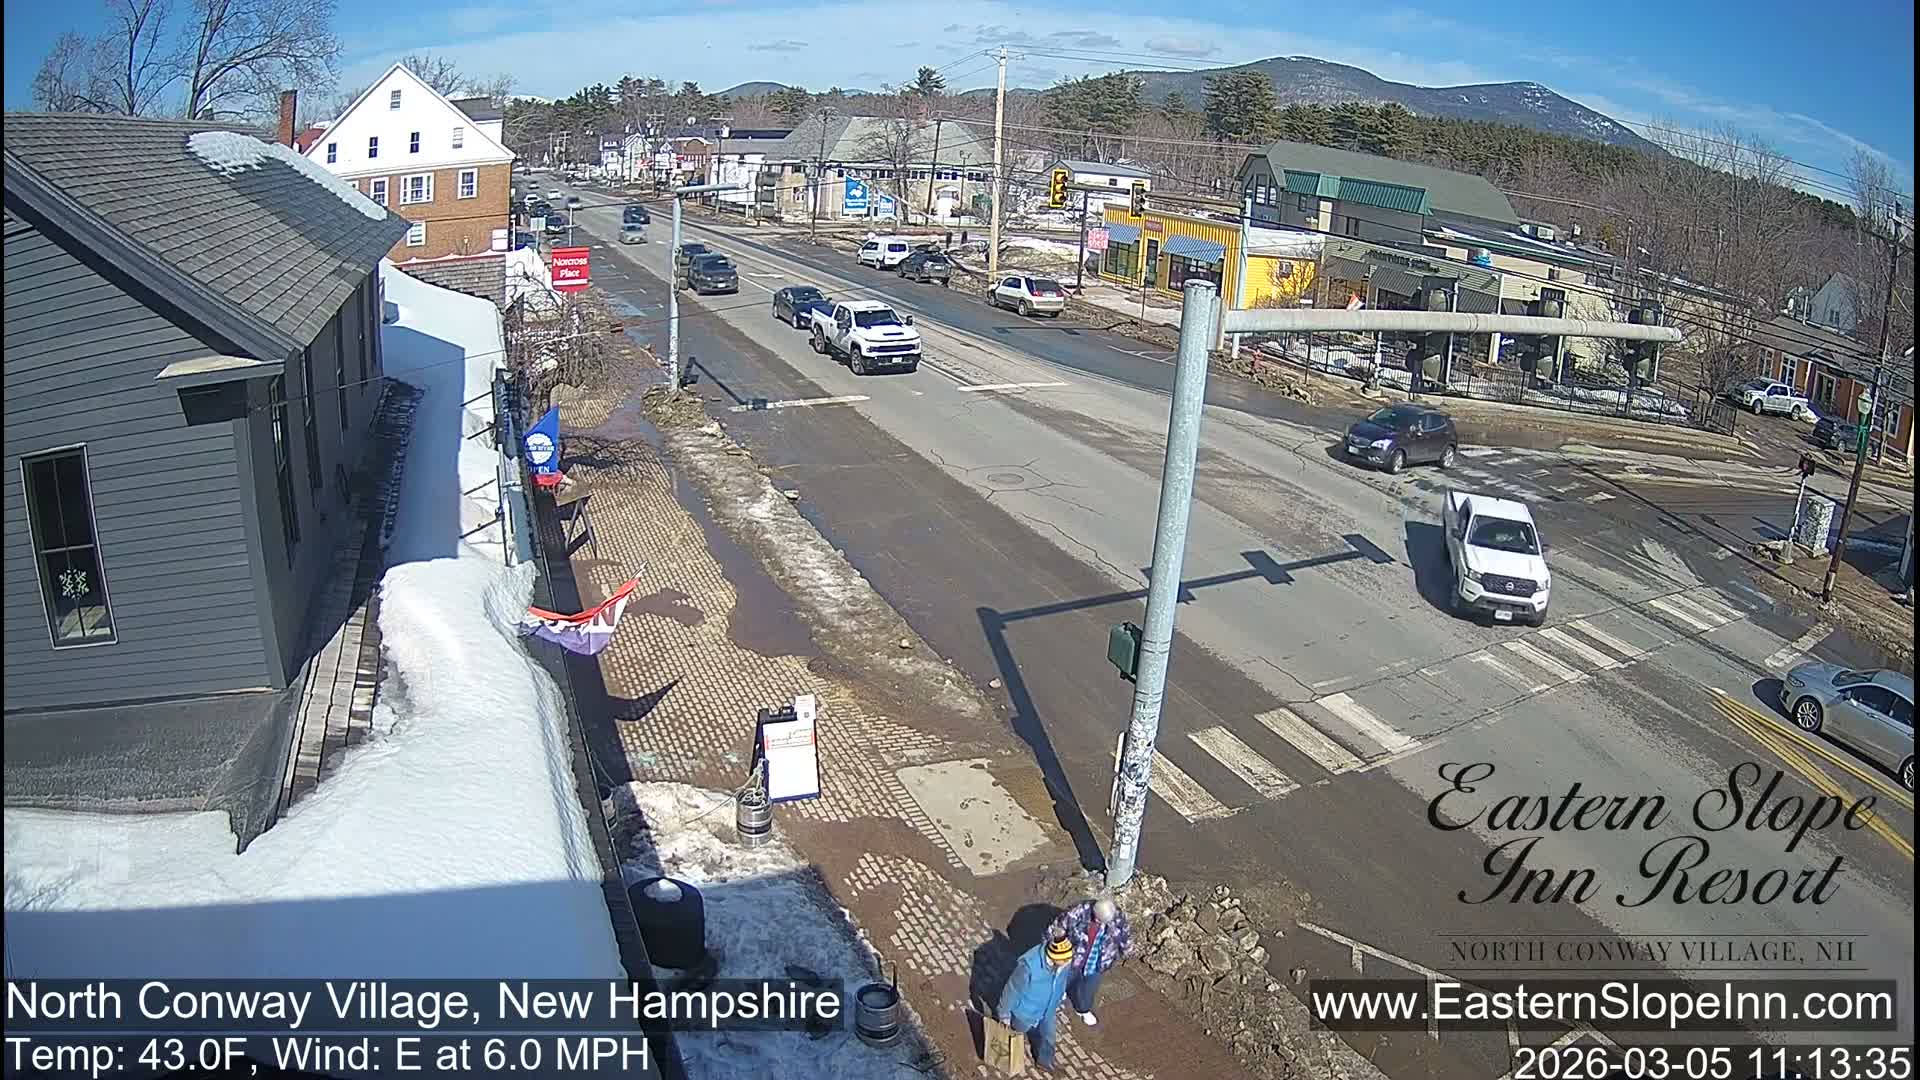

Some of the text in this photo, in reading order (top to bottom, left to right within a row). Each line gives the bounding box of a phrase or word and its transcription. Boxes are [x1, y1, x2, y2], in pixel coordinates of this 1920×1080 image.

[552, 257, 588, 267] Norcross
[559, 268, 581, 278] Place
[527, 465, 550, 473] OPEN
